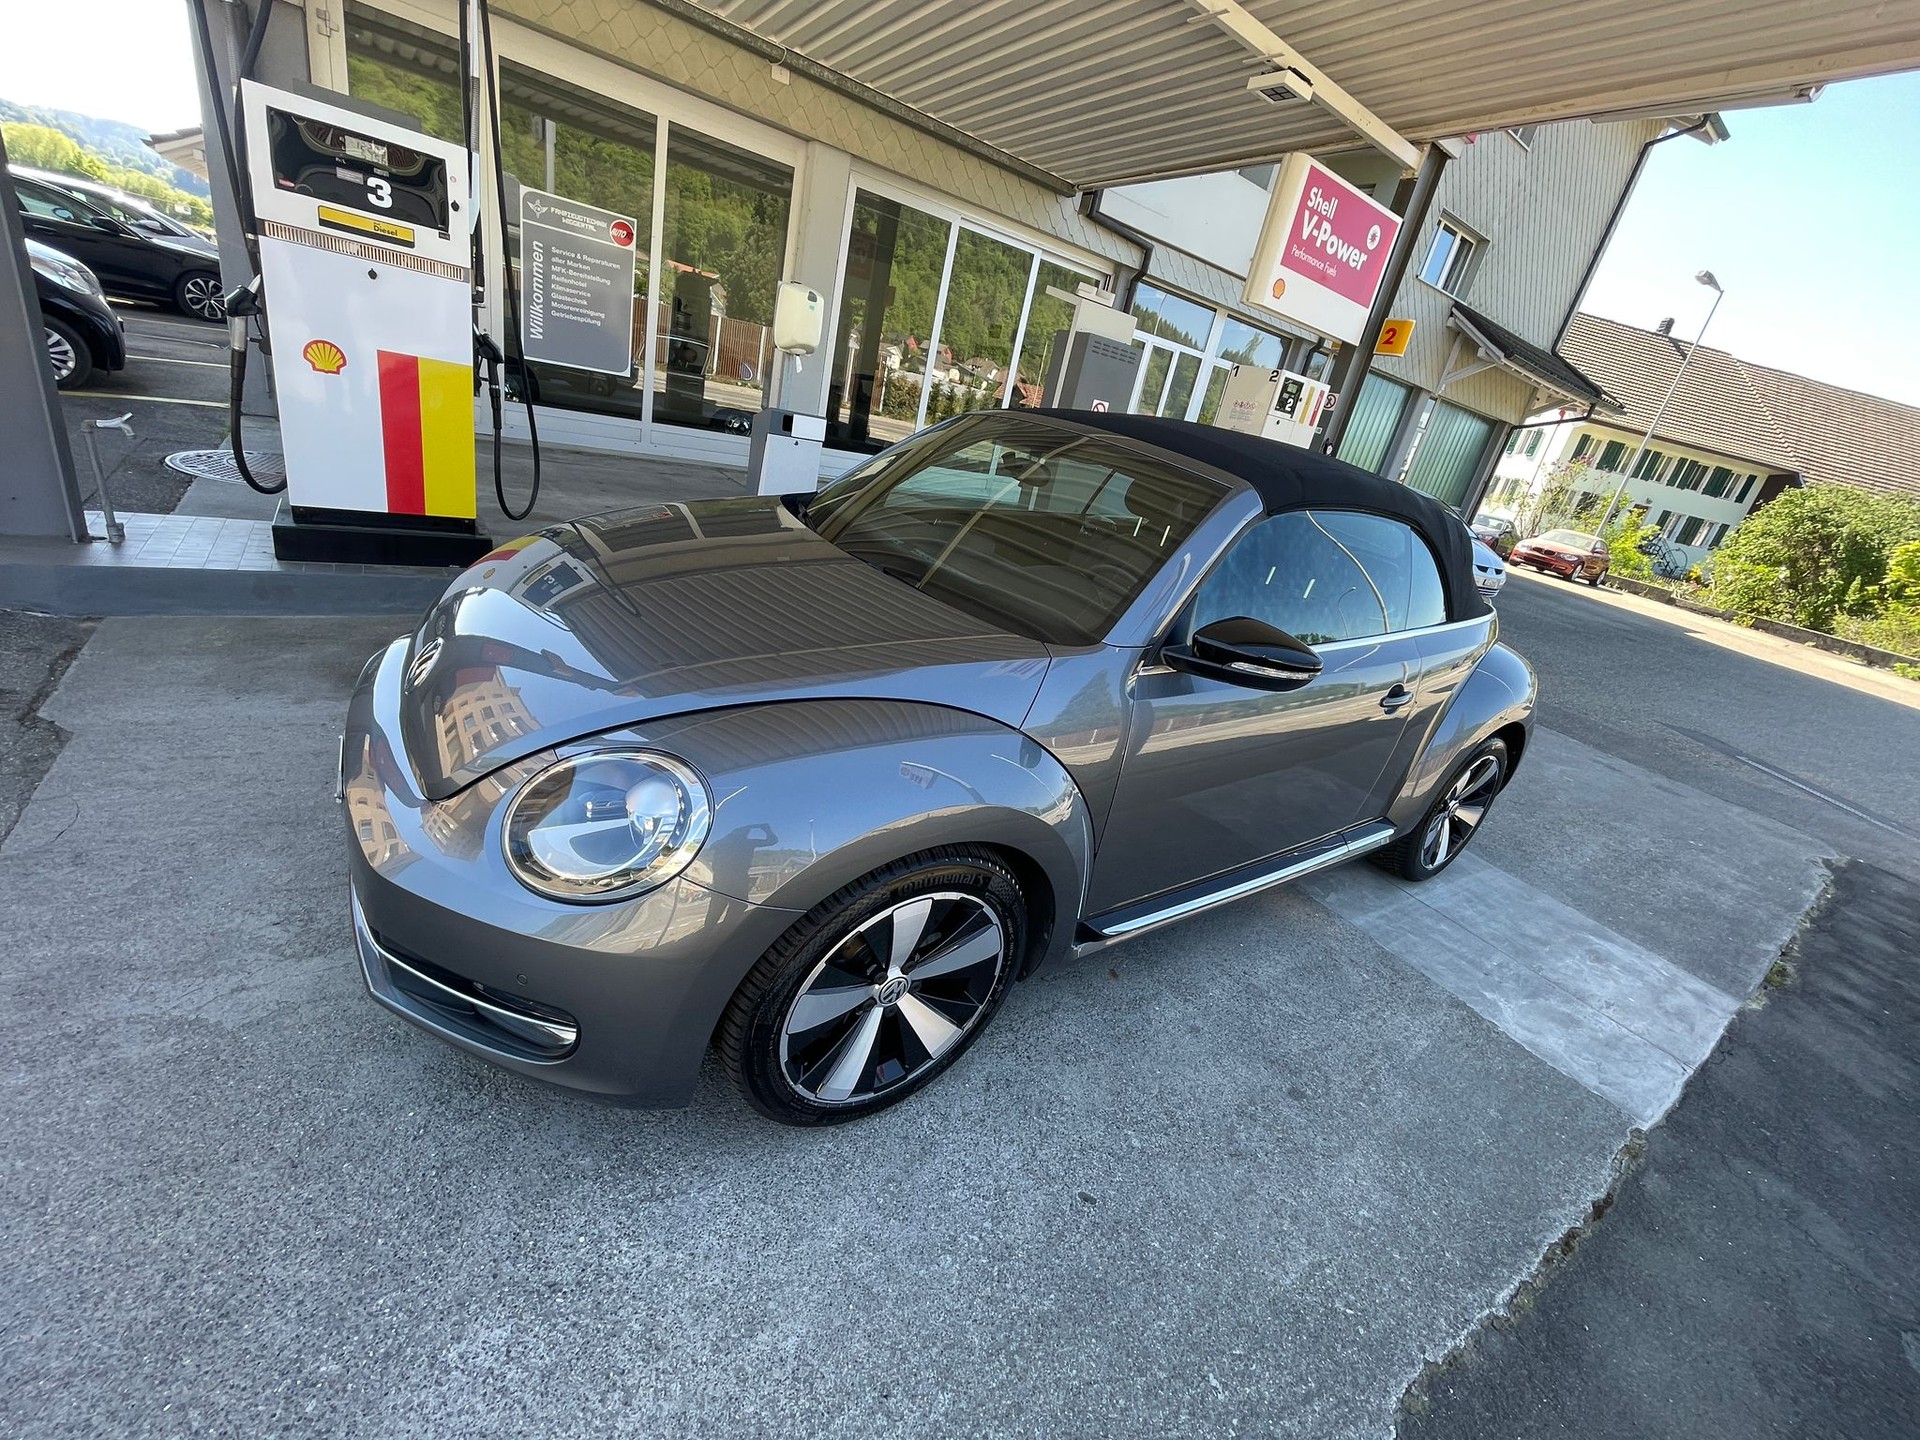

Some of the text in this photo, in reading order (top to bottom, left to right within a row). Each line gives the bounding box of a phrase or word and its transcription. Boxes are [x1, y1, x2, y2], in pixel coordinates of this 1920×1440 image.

[366, 177, 393, 208] 3
[1307, 186, 1339, 220] Shell
[373, 224, 398, 236] Diesel
[1302, 209, 1368, 271] V-Power
[551, 246, 576, 258] Service
[582, 254, 621, 270] Reparaturen
[551, 256, 591, 271] aller Marken
[1291, 244, 1338, 277] Performance Fuels
[551, 265, 611, 286] MFK-Bereitstellung
[551, 274, 587, 288] Reifenhotel
[529, 240, 544, 340] Willkommen
[551, 283, 591, 297] Klimaservice
[551, 292, 588, 306] Glastechnik
[551, 301, 606, 319] Motorenreinigung
[551, 310, 601, 327] Getriebespülung
[1381, 327, 1397, 345] 2
[1233, 365, 1240, 377] 1
[1269, 370, 1279, 382] 2
[1285, 398, 1294, 411] 2
